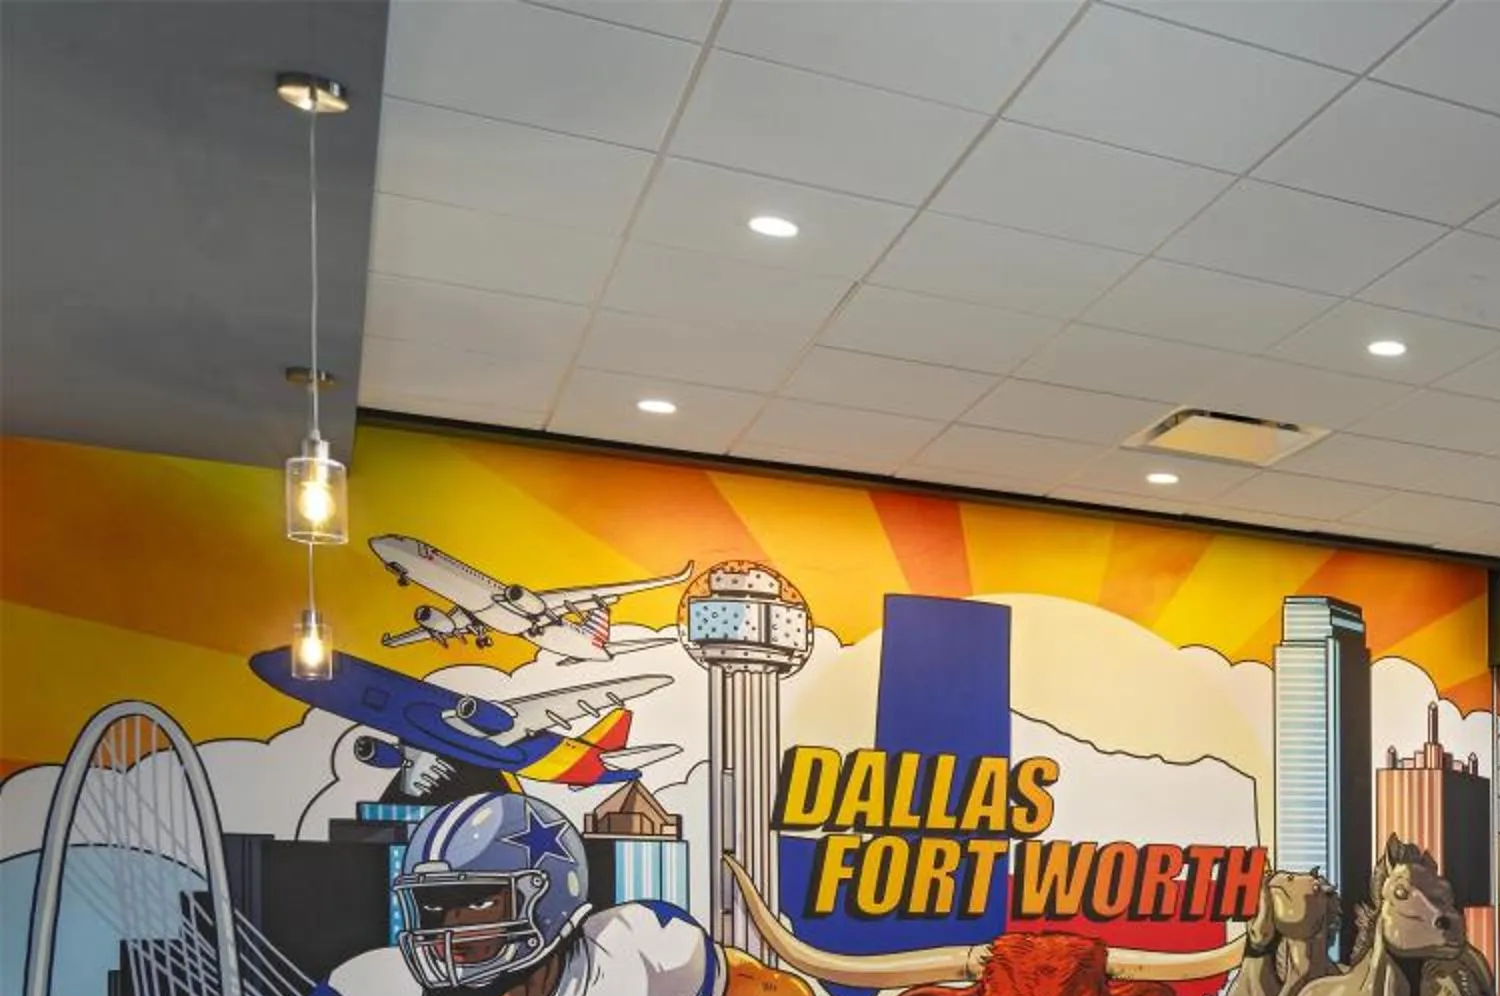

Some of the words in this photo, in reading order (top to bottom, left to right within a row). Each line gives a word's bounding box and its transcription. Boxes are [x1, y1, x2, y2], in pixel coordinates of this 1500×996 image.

[775, 746, 1060, 837] DALLAS
[807, 835, 1009, 916] FORT
[1015, 839, 1268, 919] WORTH
